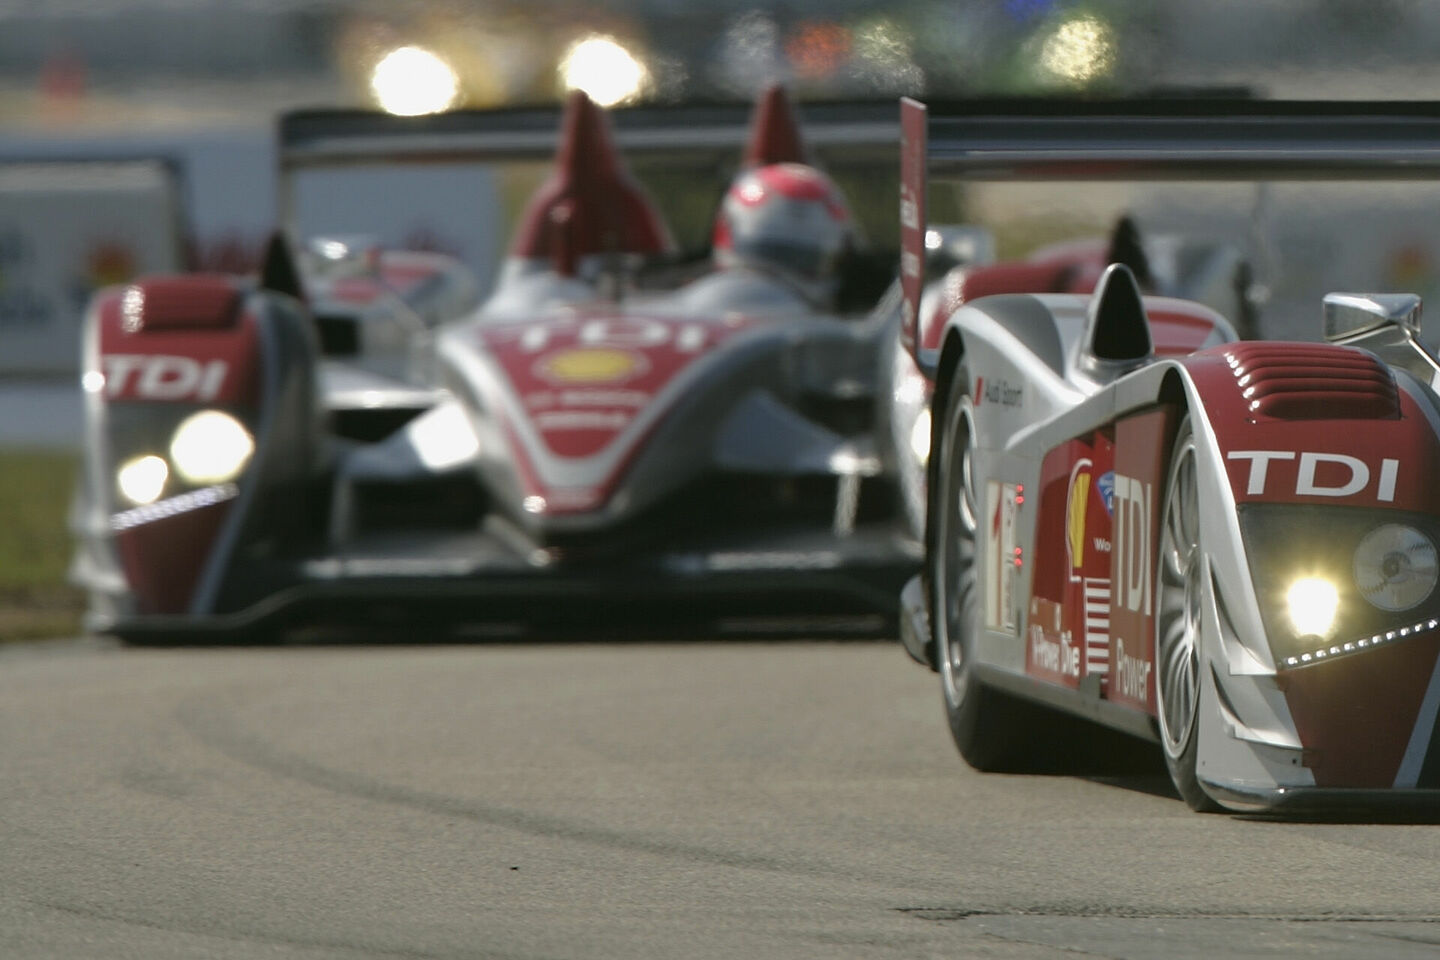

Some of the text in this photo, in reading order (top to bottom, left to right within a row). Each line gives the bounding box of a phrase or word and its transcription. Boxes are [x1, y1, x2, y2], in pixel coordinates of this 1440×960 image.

[99, 353, 229, 401] TDI
[1227, 450, 1399, 501] TDI
[1114, 474, 1152, 617] TDI
[1116, 638, 1151, 702] Power
